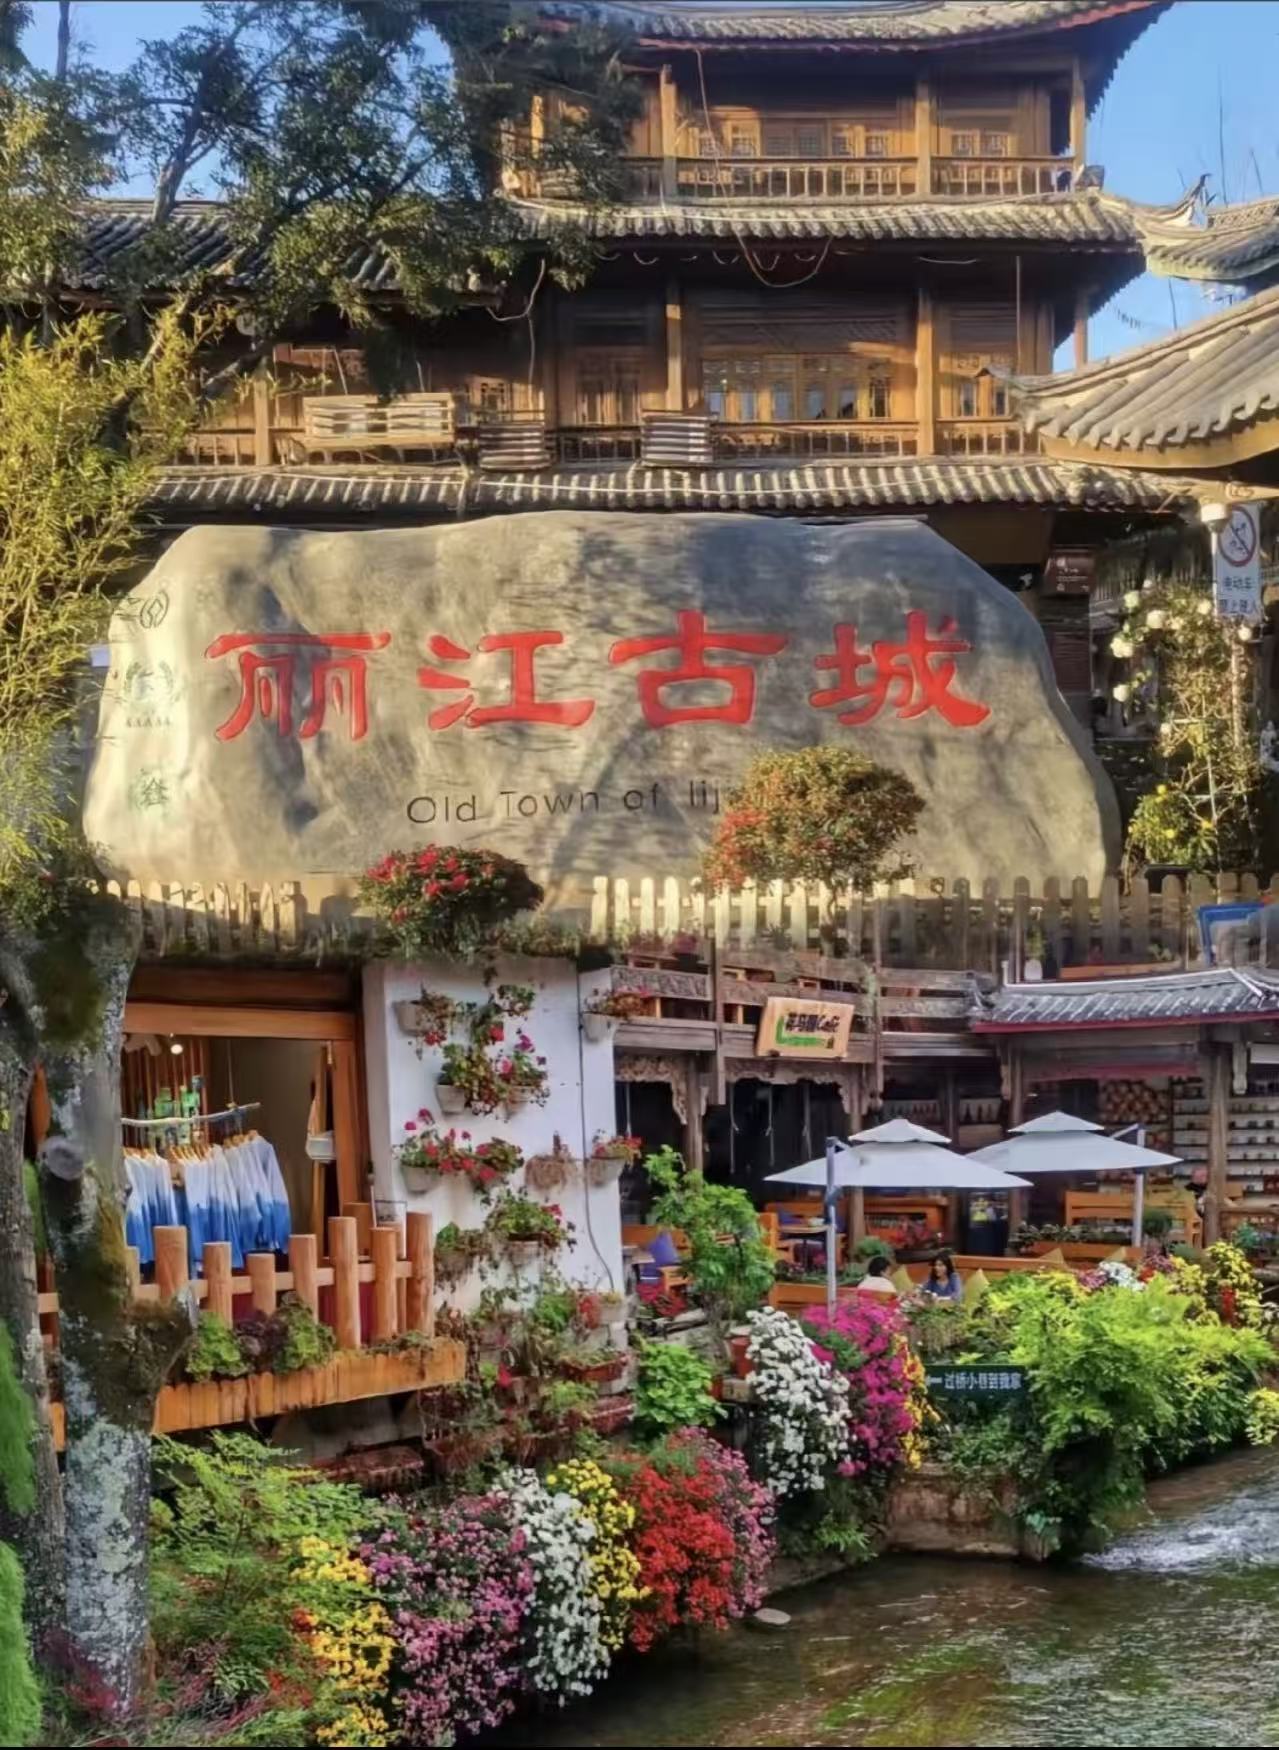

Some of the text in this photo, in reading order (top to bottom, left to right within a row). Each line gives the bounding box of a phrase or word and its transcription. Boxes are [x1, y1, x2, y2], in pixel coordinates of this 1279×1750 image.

[205, 609, 991, 743] 丽江古城
[406, 795, 477, 824] Old
[500, 790, 600, 818] Town
[623, 783, 659, 811] of
